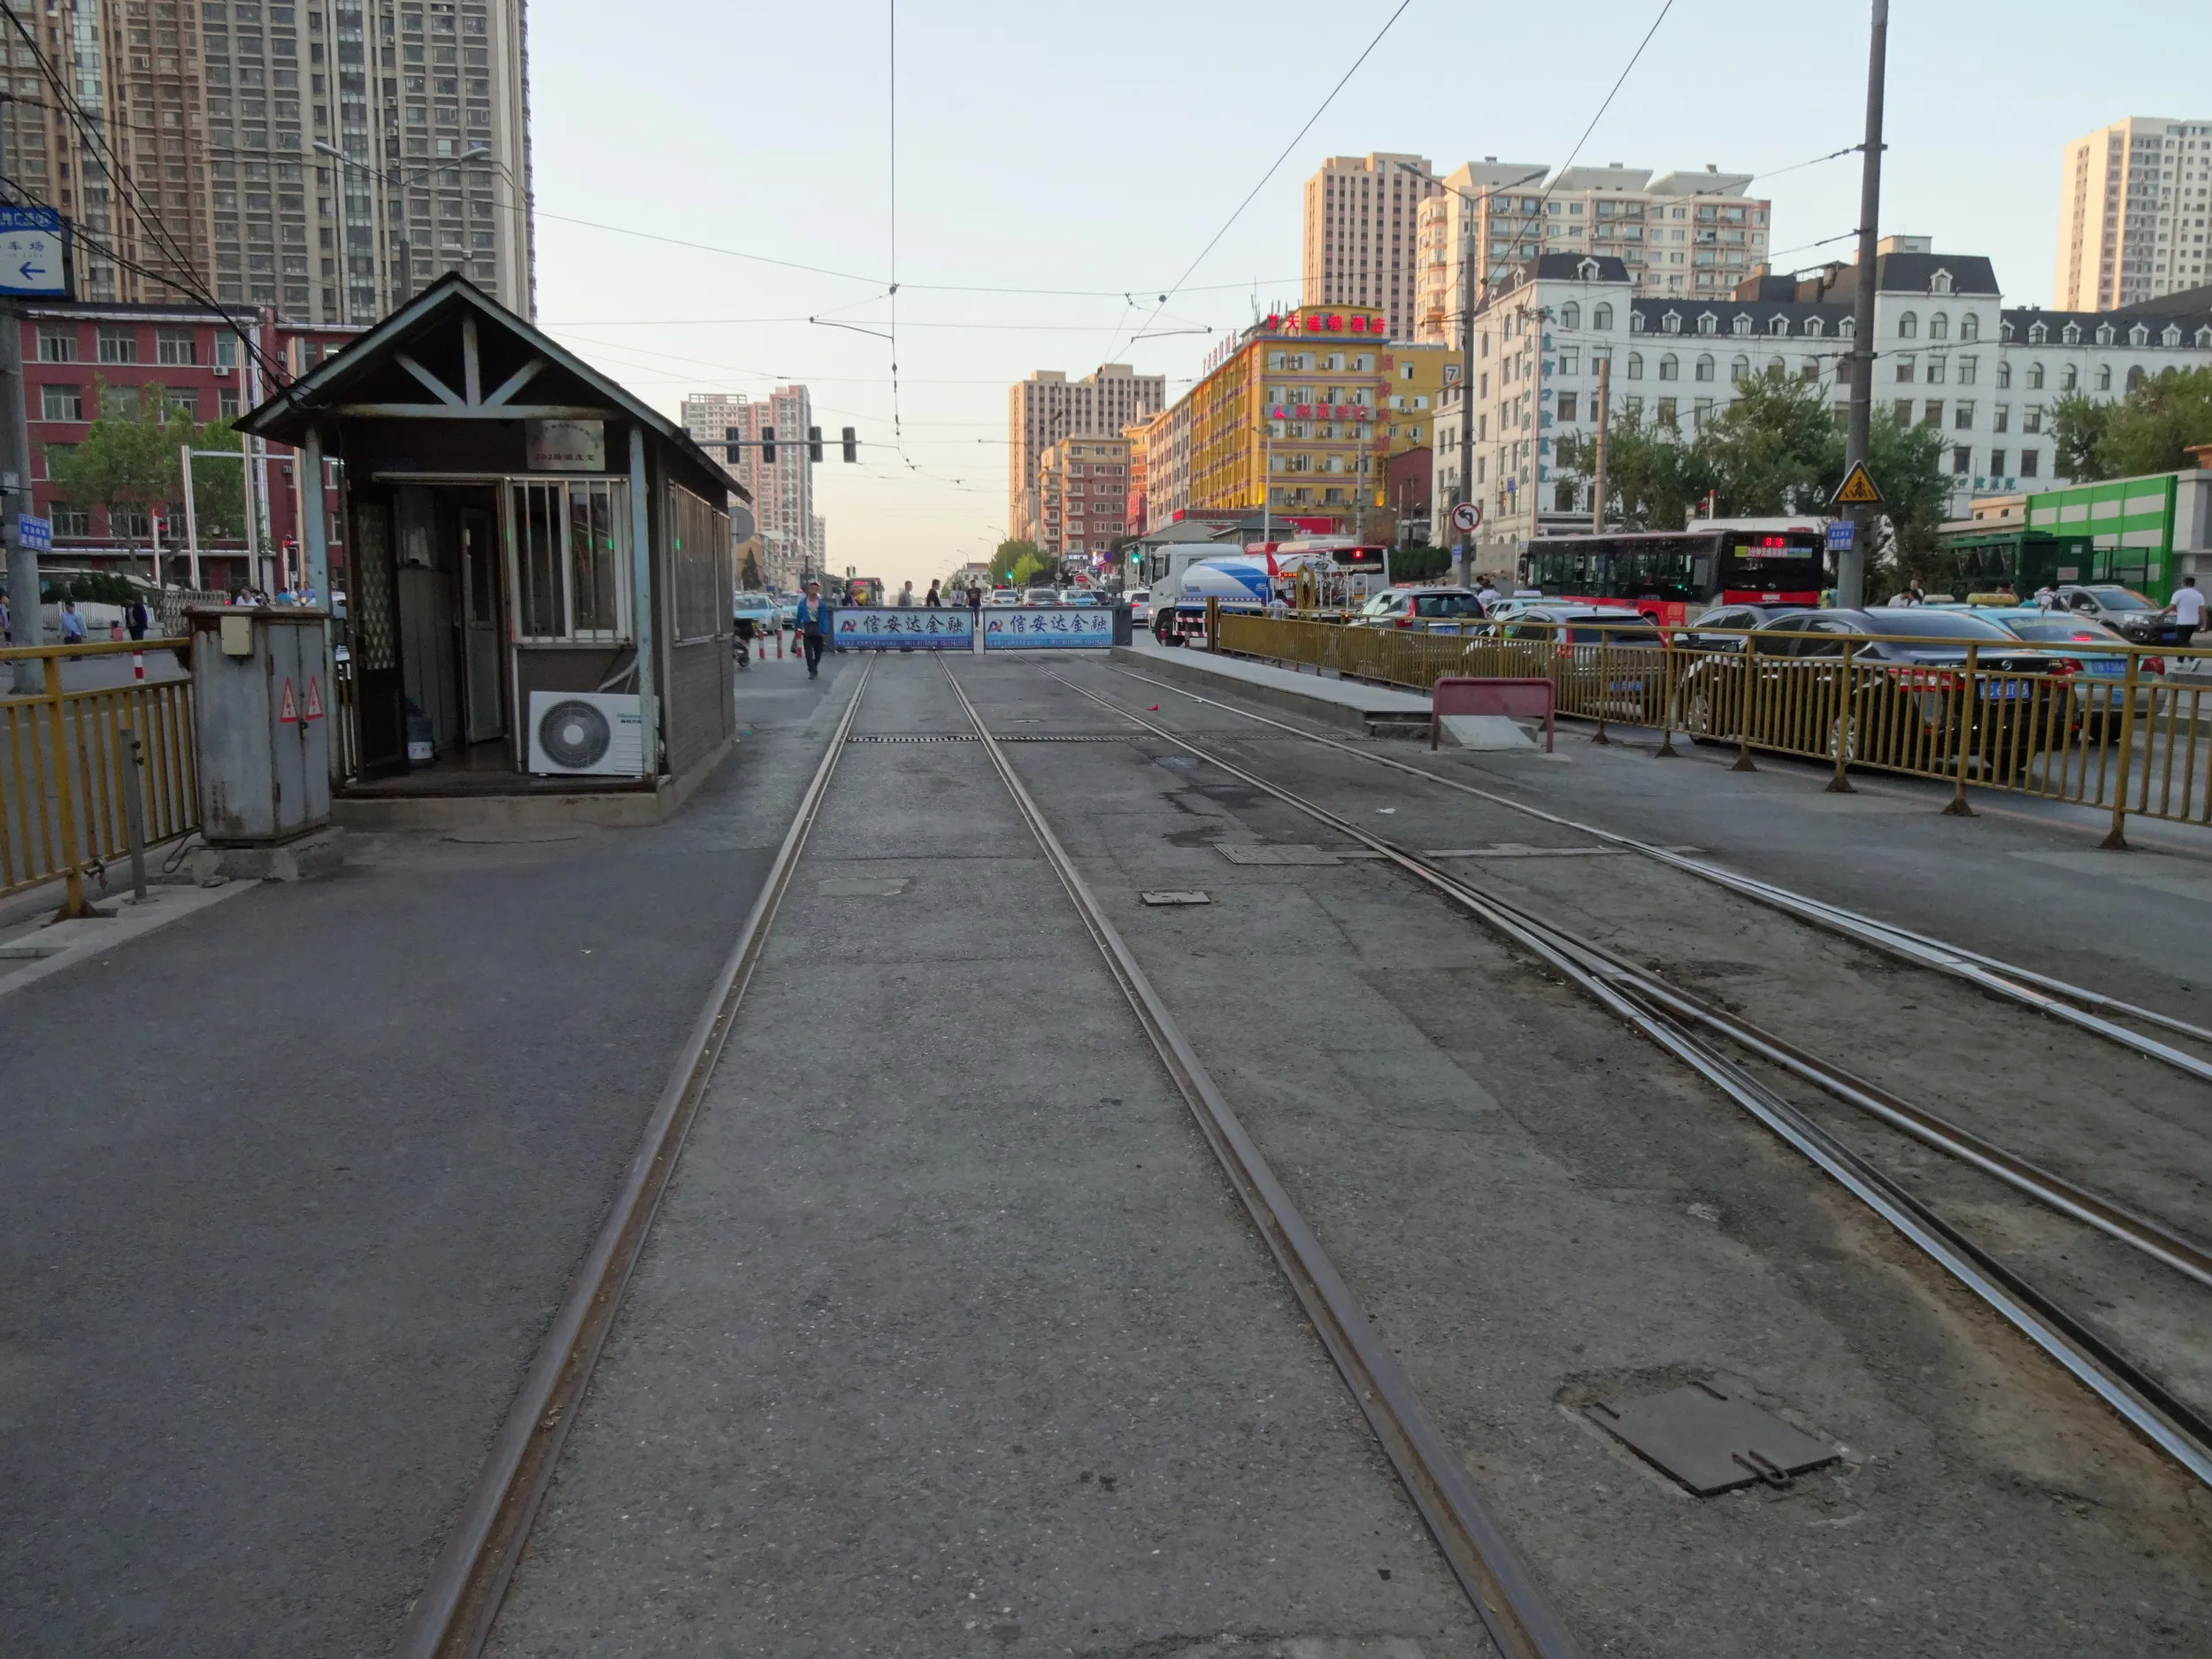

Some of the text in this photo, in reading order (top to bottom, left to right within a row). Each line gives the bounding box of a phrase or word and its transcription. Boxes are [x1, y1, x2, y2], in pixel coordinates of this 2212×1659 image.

[864, 614, 964, 634] 信安达金融
[1010, 612, 1107, 634] 信安达金融
